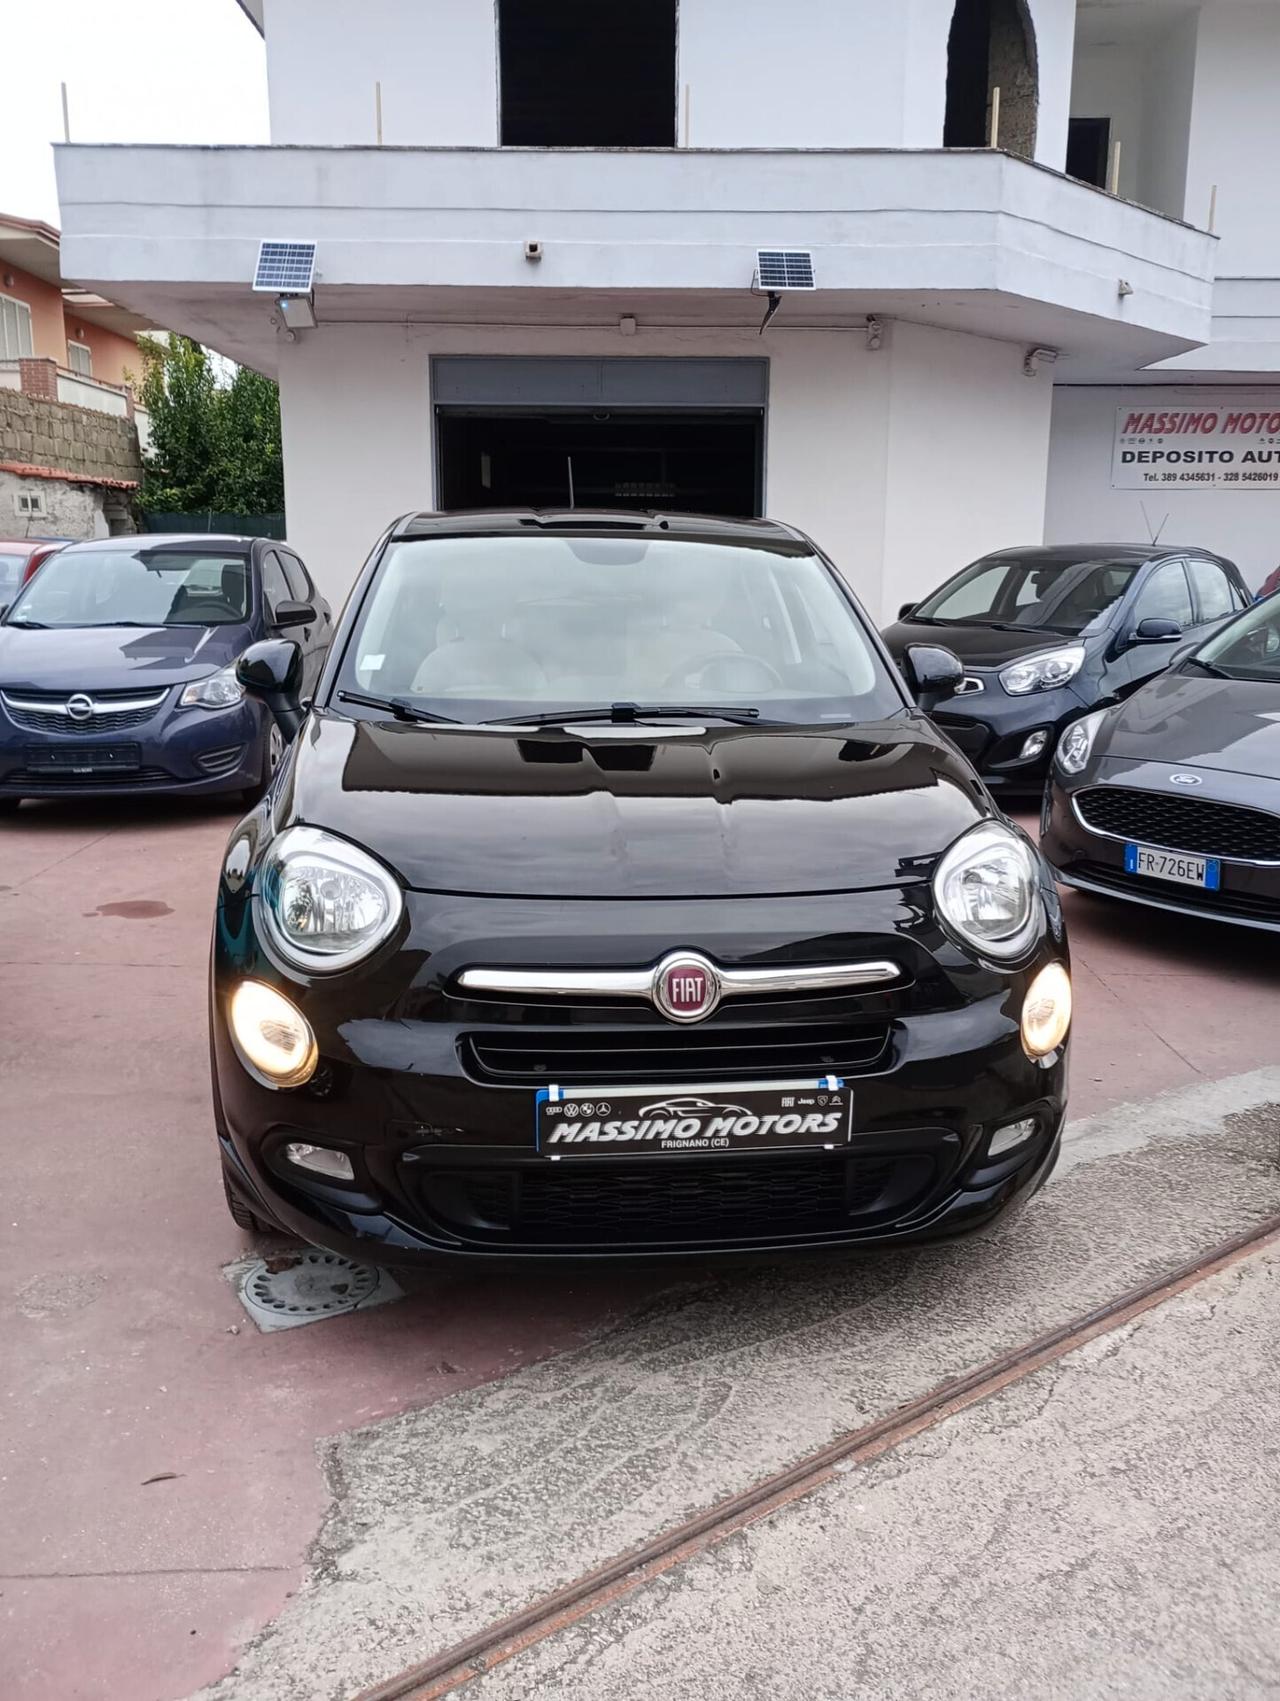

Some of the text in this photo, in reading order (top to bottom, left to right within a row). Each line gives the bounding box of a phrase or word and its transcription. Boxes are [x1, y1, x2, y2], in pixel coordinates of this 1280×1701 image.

[1122, 412, 1218, 434] MASSIMO
[1121, 450, 1234, 464] DEPOSITO
[1144, 473, 1159, 482] Tel.
[1161, 473, 1177, 482] 389
[1179, 473, 1215, 482] 4345631
[1223, 473, 1239, 482] 328
[1241, 473, 1279, 482] 5426019
[672, 977, 703, 1003] FIAT
[548, 1112, 843, 1143] MASSIMO MOTORS
[661, 1138, 730, 1149] FRIGNANO (CE)
